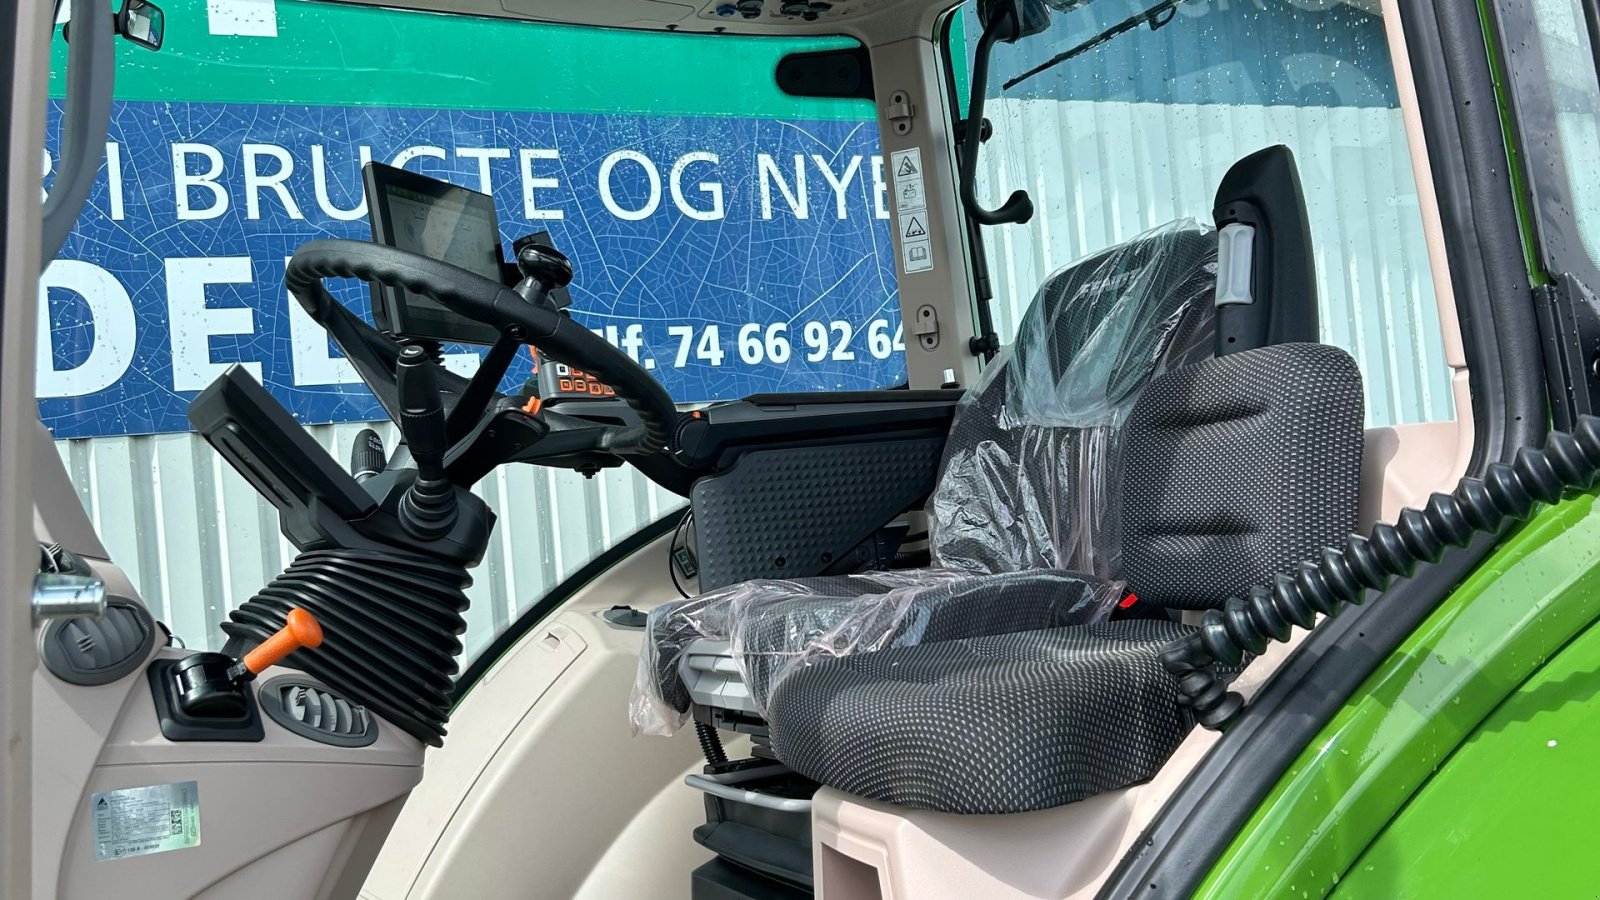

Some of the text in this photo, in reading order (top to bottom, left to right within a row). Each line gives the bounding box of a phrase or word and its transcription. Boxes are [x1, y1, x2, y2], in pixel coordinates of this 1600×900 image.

[106, 142, 124, 220] I
[598, 149, 725, 221] OG
[668, 325, 723, 368] 74
[739, 322, 791, 365] 66
[803, 320, 855, 362] 92
